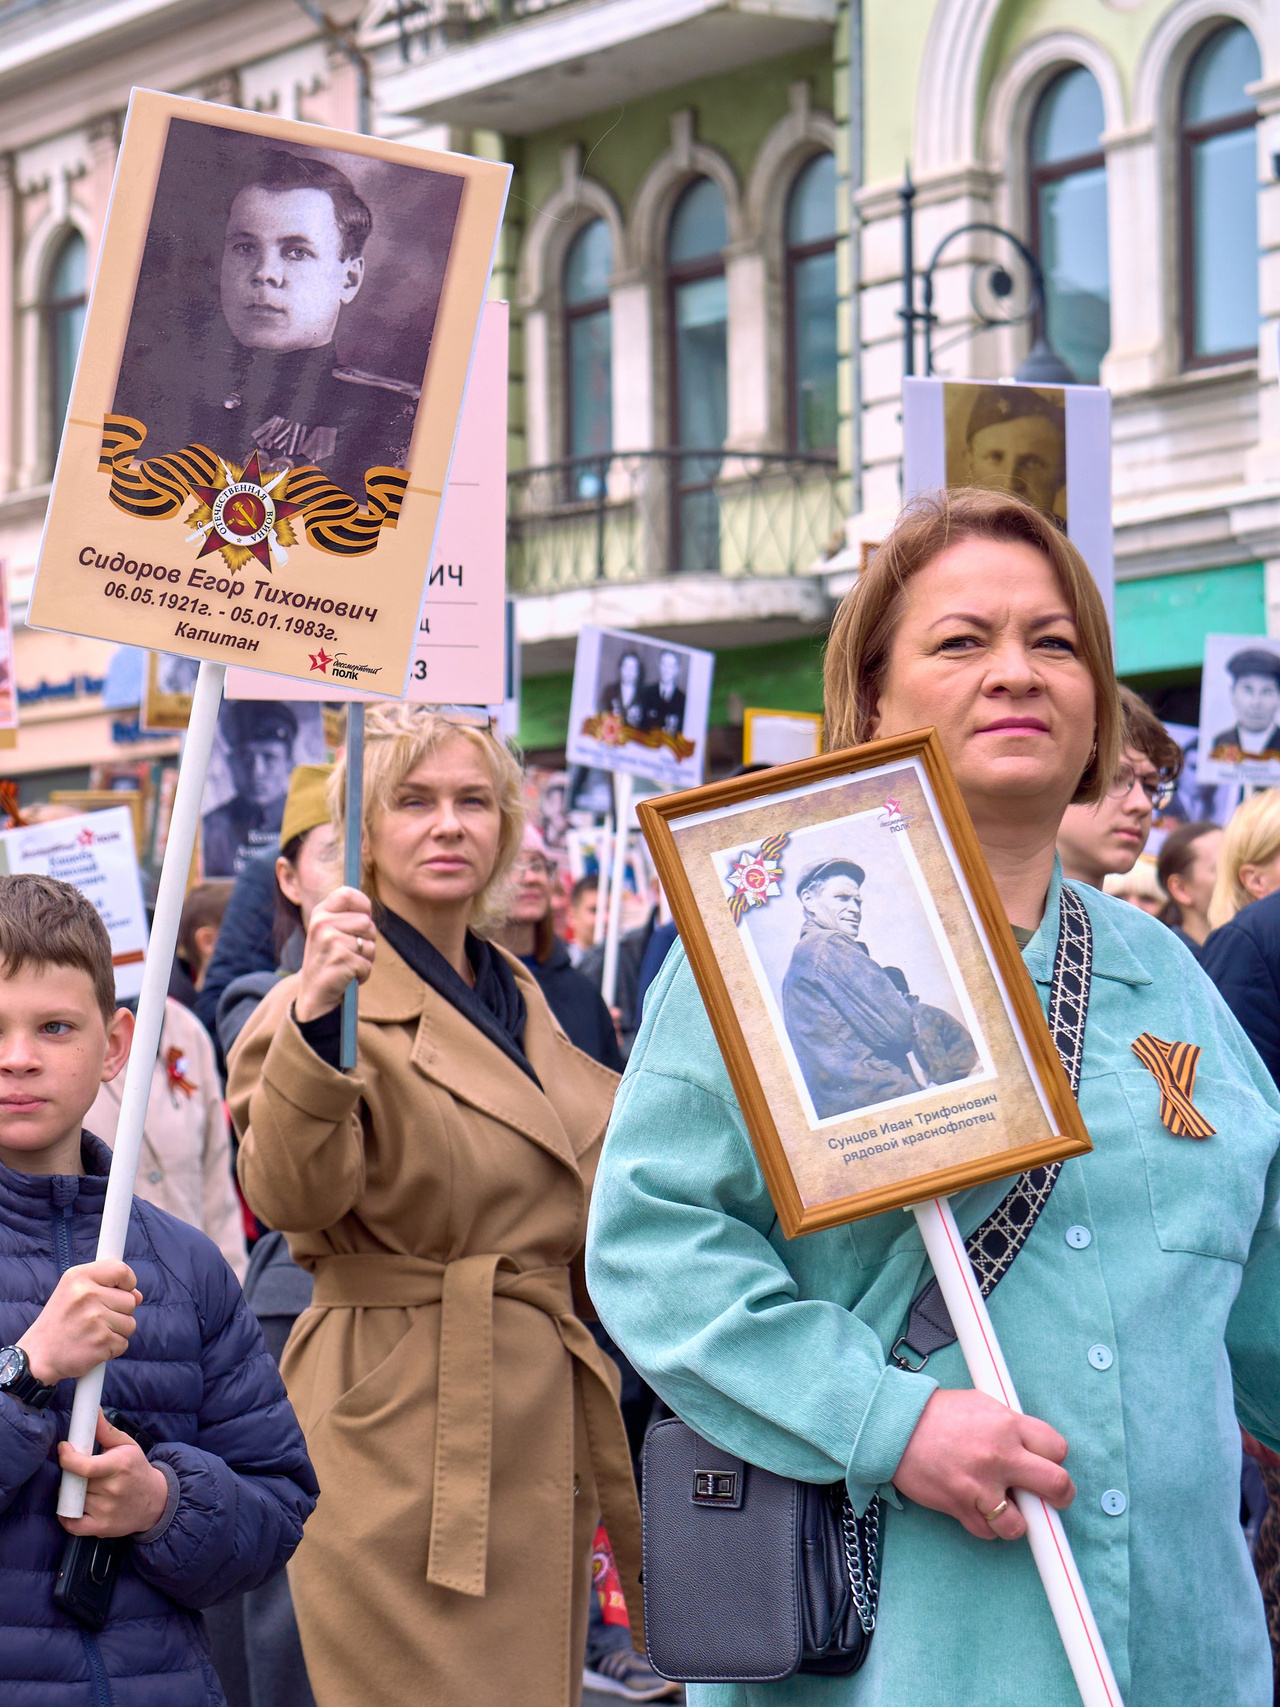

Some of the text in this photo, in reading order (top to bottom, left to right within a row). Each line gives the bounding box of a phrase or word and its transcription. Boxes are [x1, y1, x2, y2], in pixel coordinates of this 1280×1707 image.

[214, 484, 268, 535] ОТЕЧЕСТВЕННАЯ
[78, 546, 378, 623] Сидоров Егор Тихонович
[104, 581, 213, 617] 06.05.1921г.
[230, 606, 338, 641] 05.01.1983г.
[175, 621, 260, 652] Капитан
[332, 668, 359, 681] ПОЛК
[828, 1093, 998, 1150] Сунцов Иван Трифонович
[842, 1111, 996, 1166] рядовой краснофлотец
